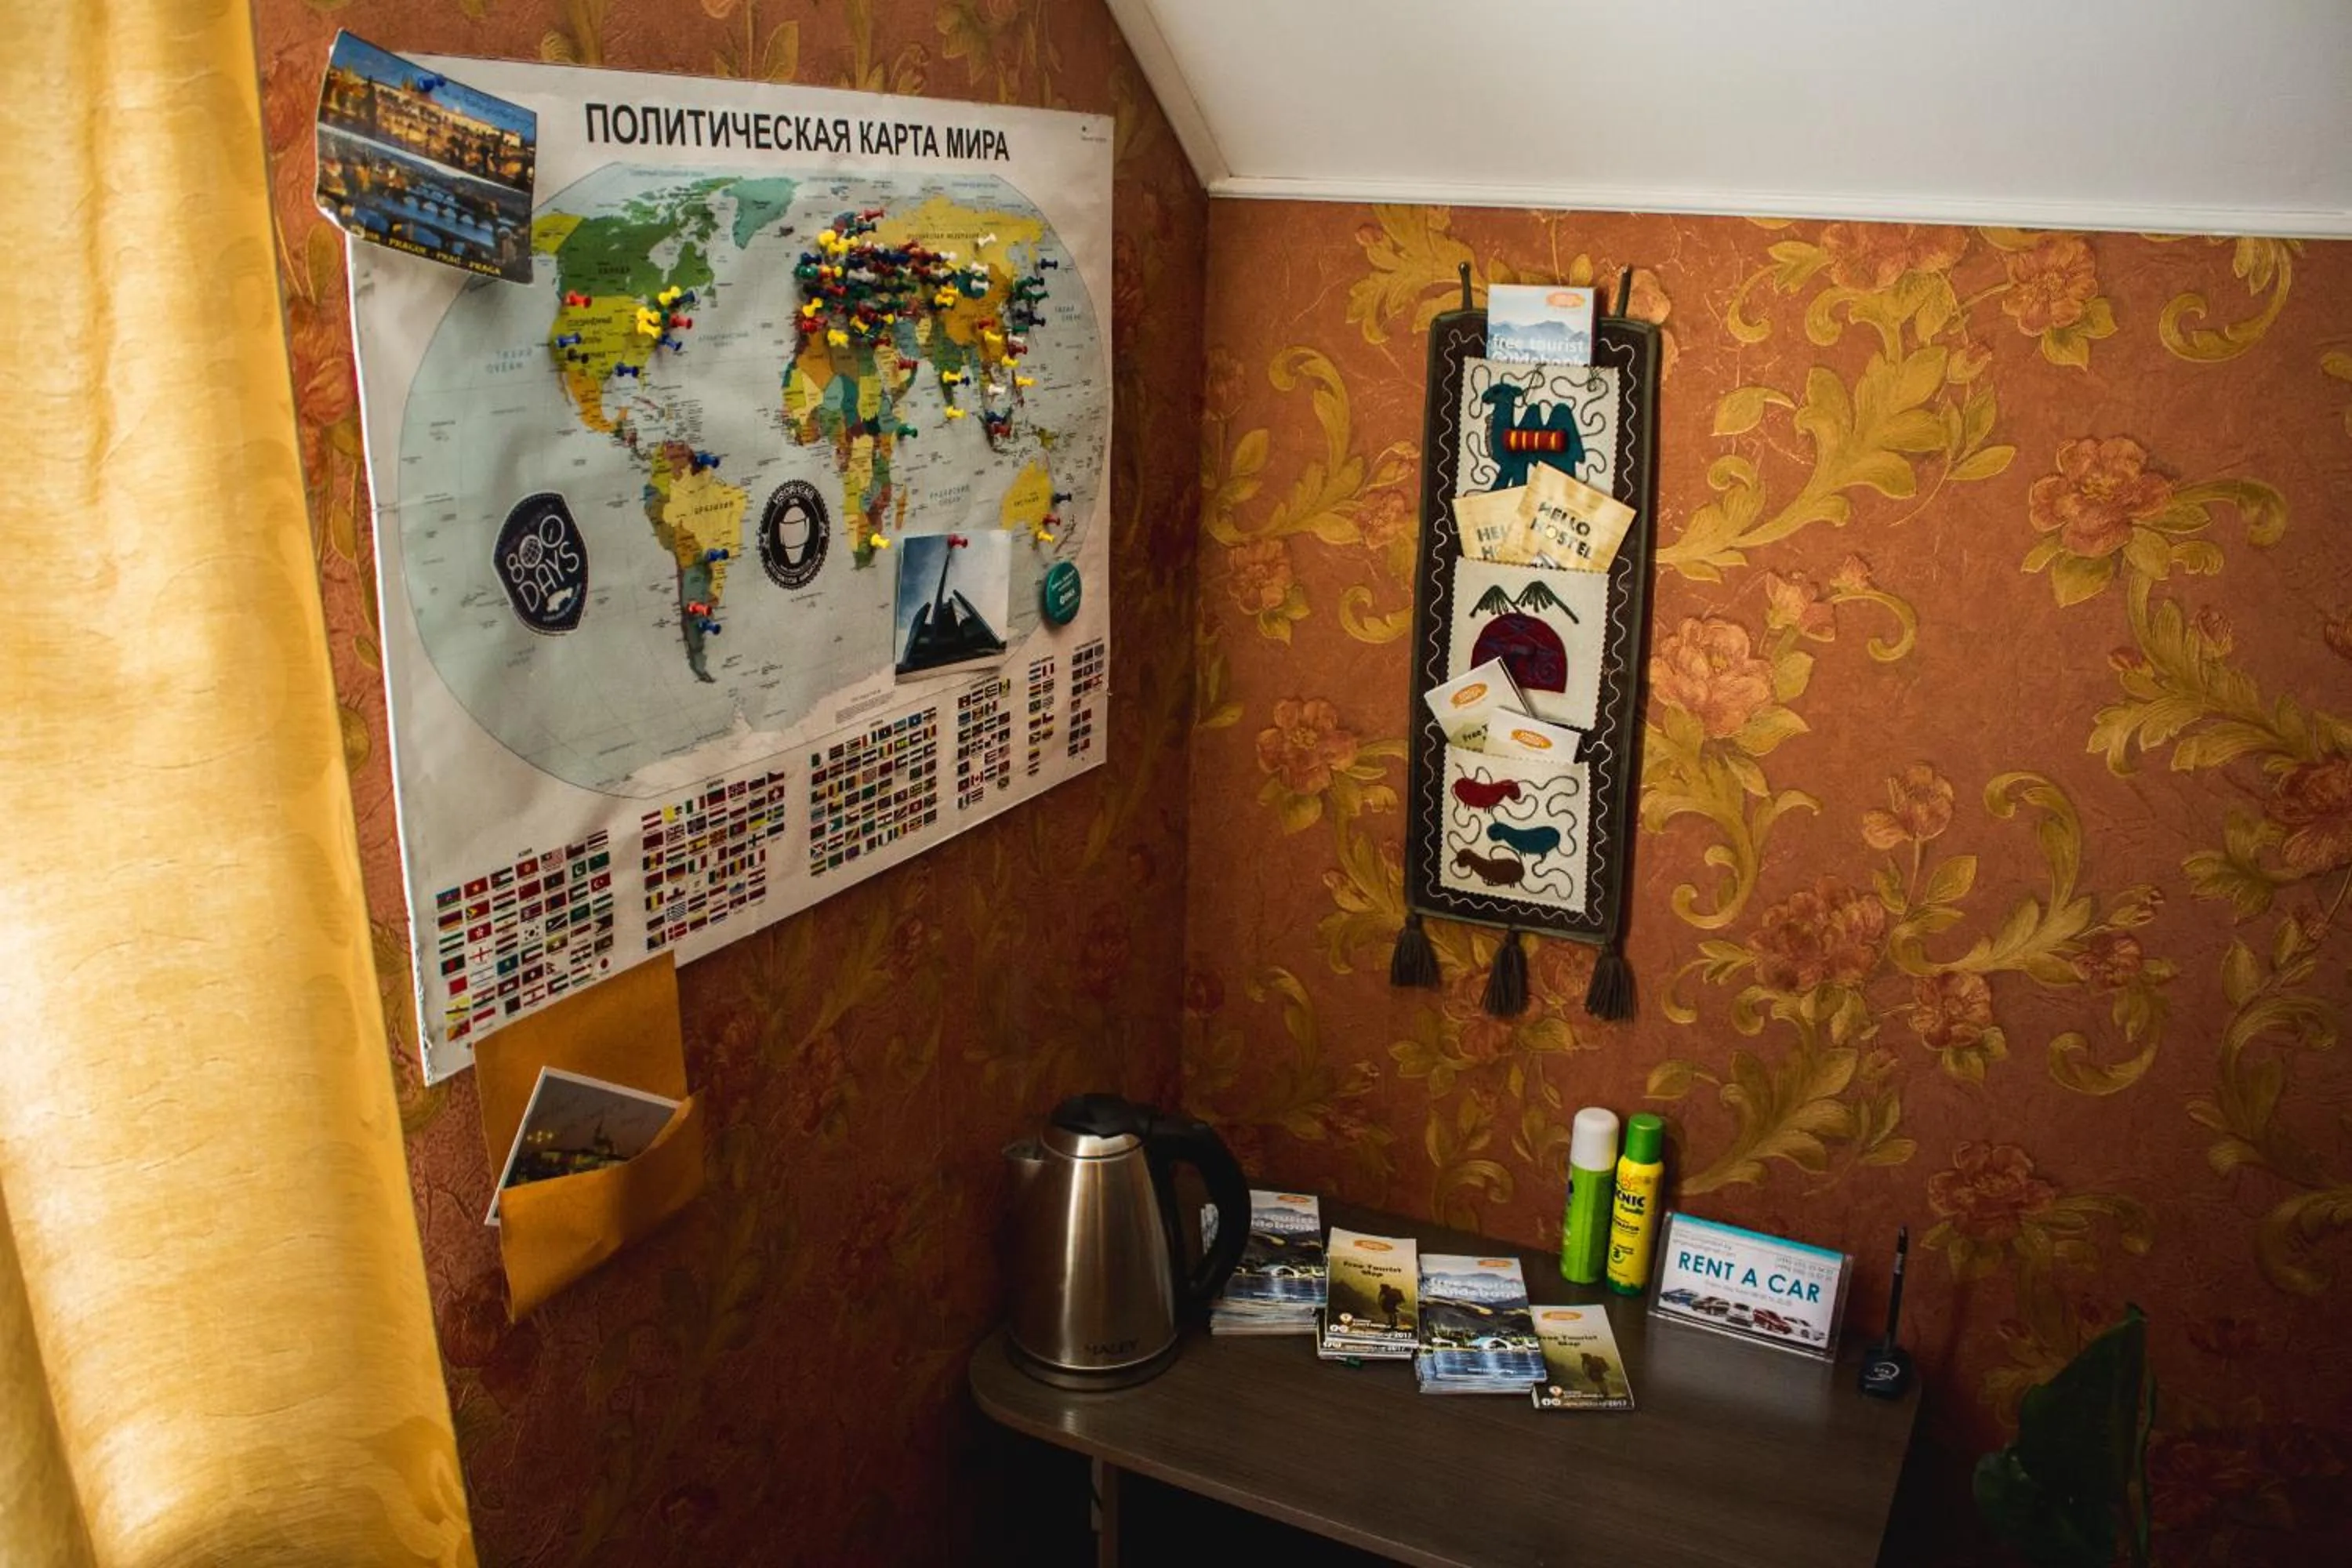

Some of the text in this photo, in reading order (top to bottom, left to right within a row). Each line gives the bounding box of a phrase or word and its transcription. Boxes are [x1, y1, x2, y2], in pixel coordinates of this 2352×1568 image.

[586, 103, 1011, 162] ПОЛИТИЧЕСКАЯ КАРТА МИРА
[1530, 337, 1584, 353] tourist
[1537, 501, 1591, 536] HELLO
[1530, 517, 1592, 559] HOSTEL
[518, 541, 579, 612] DAYS
[1615, 1188, 1646, 1207] CNIC
[1367, 1263, 1401, 1273] Tourist
[1678, 1250, 1735, 1280] RENT
[1741, 1268, 1758, 1288] A
[1768, 1274, 1820, 1304] CAR
